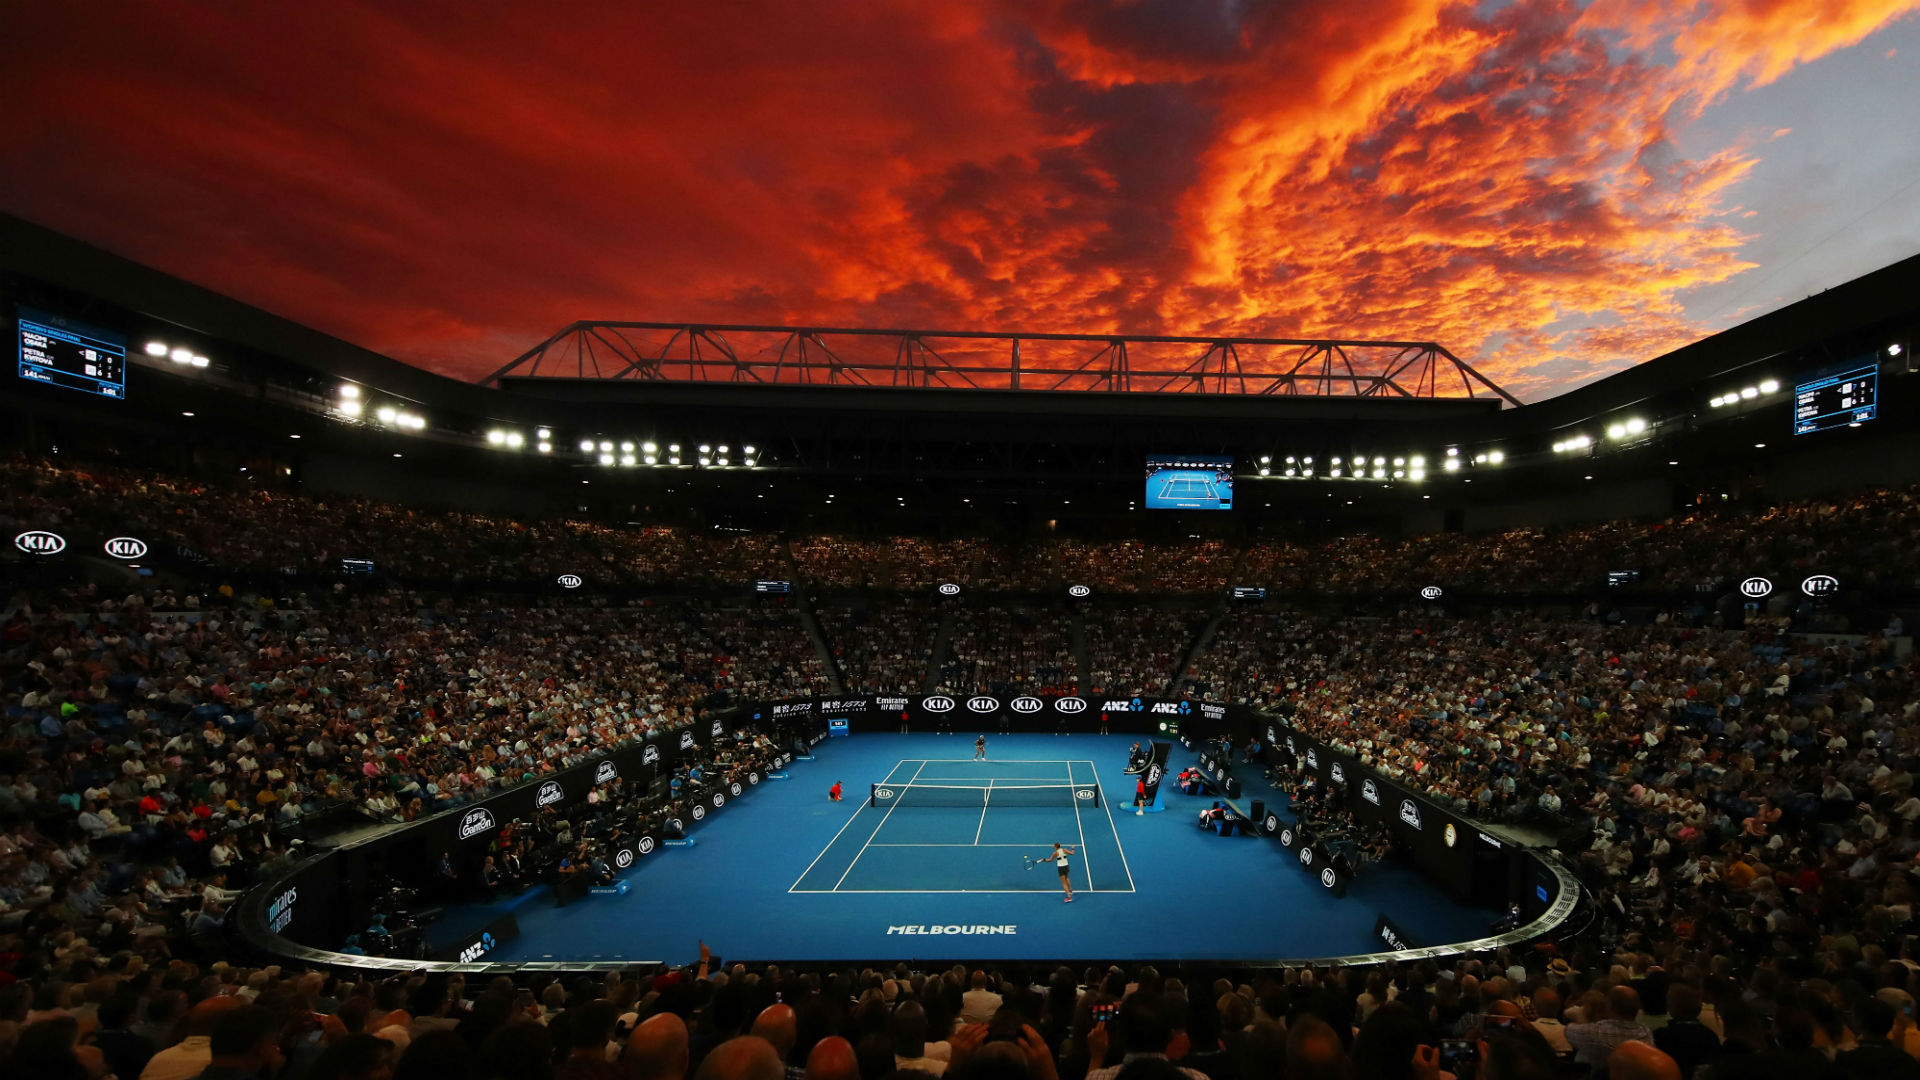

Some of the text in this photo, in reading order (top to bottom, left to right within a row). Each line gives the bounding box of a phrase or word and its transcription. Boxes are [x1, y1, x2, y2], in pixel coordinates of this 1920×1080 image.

[24, 332, 48, 343] NAOMI
[24, 338, 48, 349] OSAKA
[24, 348, 46, 358] PETRA
[24, 535, 58, 550] KIA
[112, 541, 140, 555] KIA
[1745, 582, 1766, 593] KIA
[928, 699, 950, 709] KIA
[972, 700, 994, 710] KIA
[1016, 700, 1038, 710] KIA
[1060, 700, 1082, 710] KIA
[1101, 701, 1129, 711] ANZ
[1150, 702, 1178, 714] ANZ
[1200, 703, 1226, 714] Emirates
[886, 925, 1017, 935] MELBOURNE
[460, 941, 485, 963] ANZ
